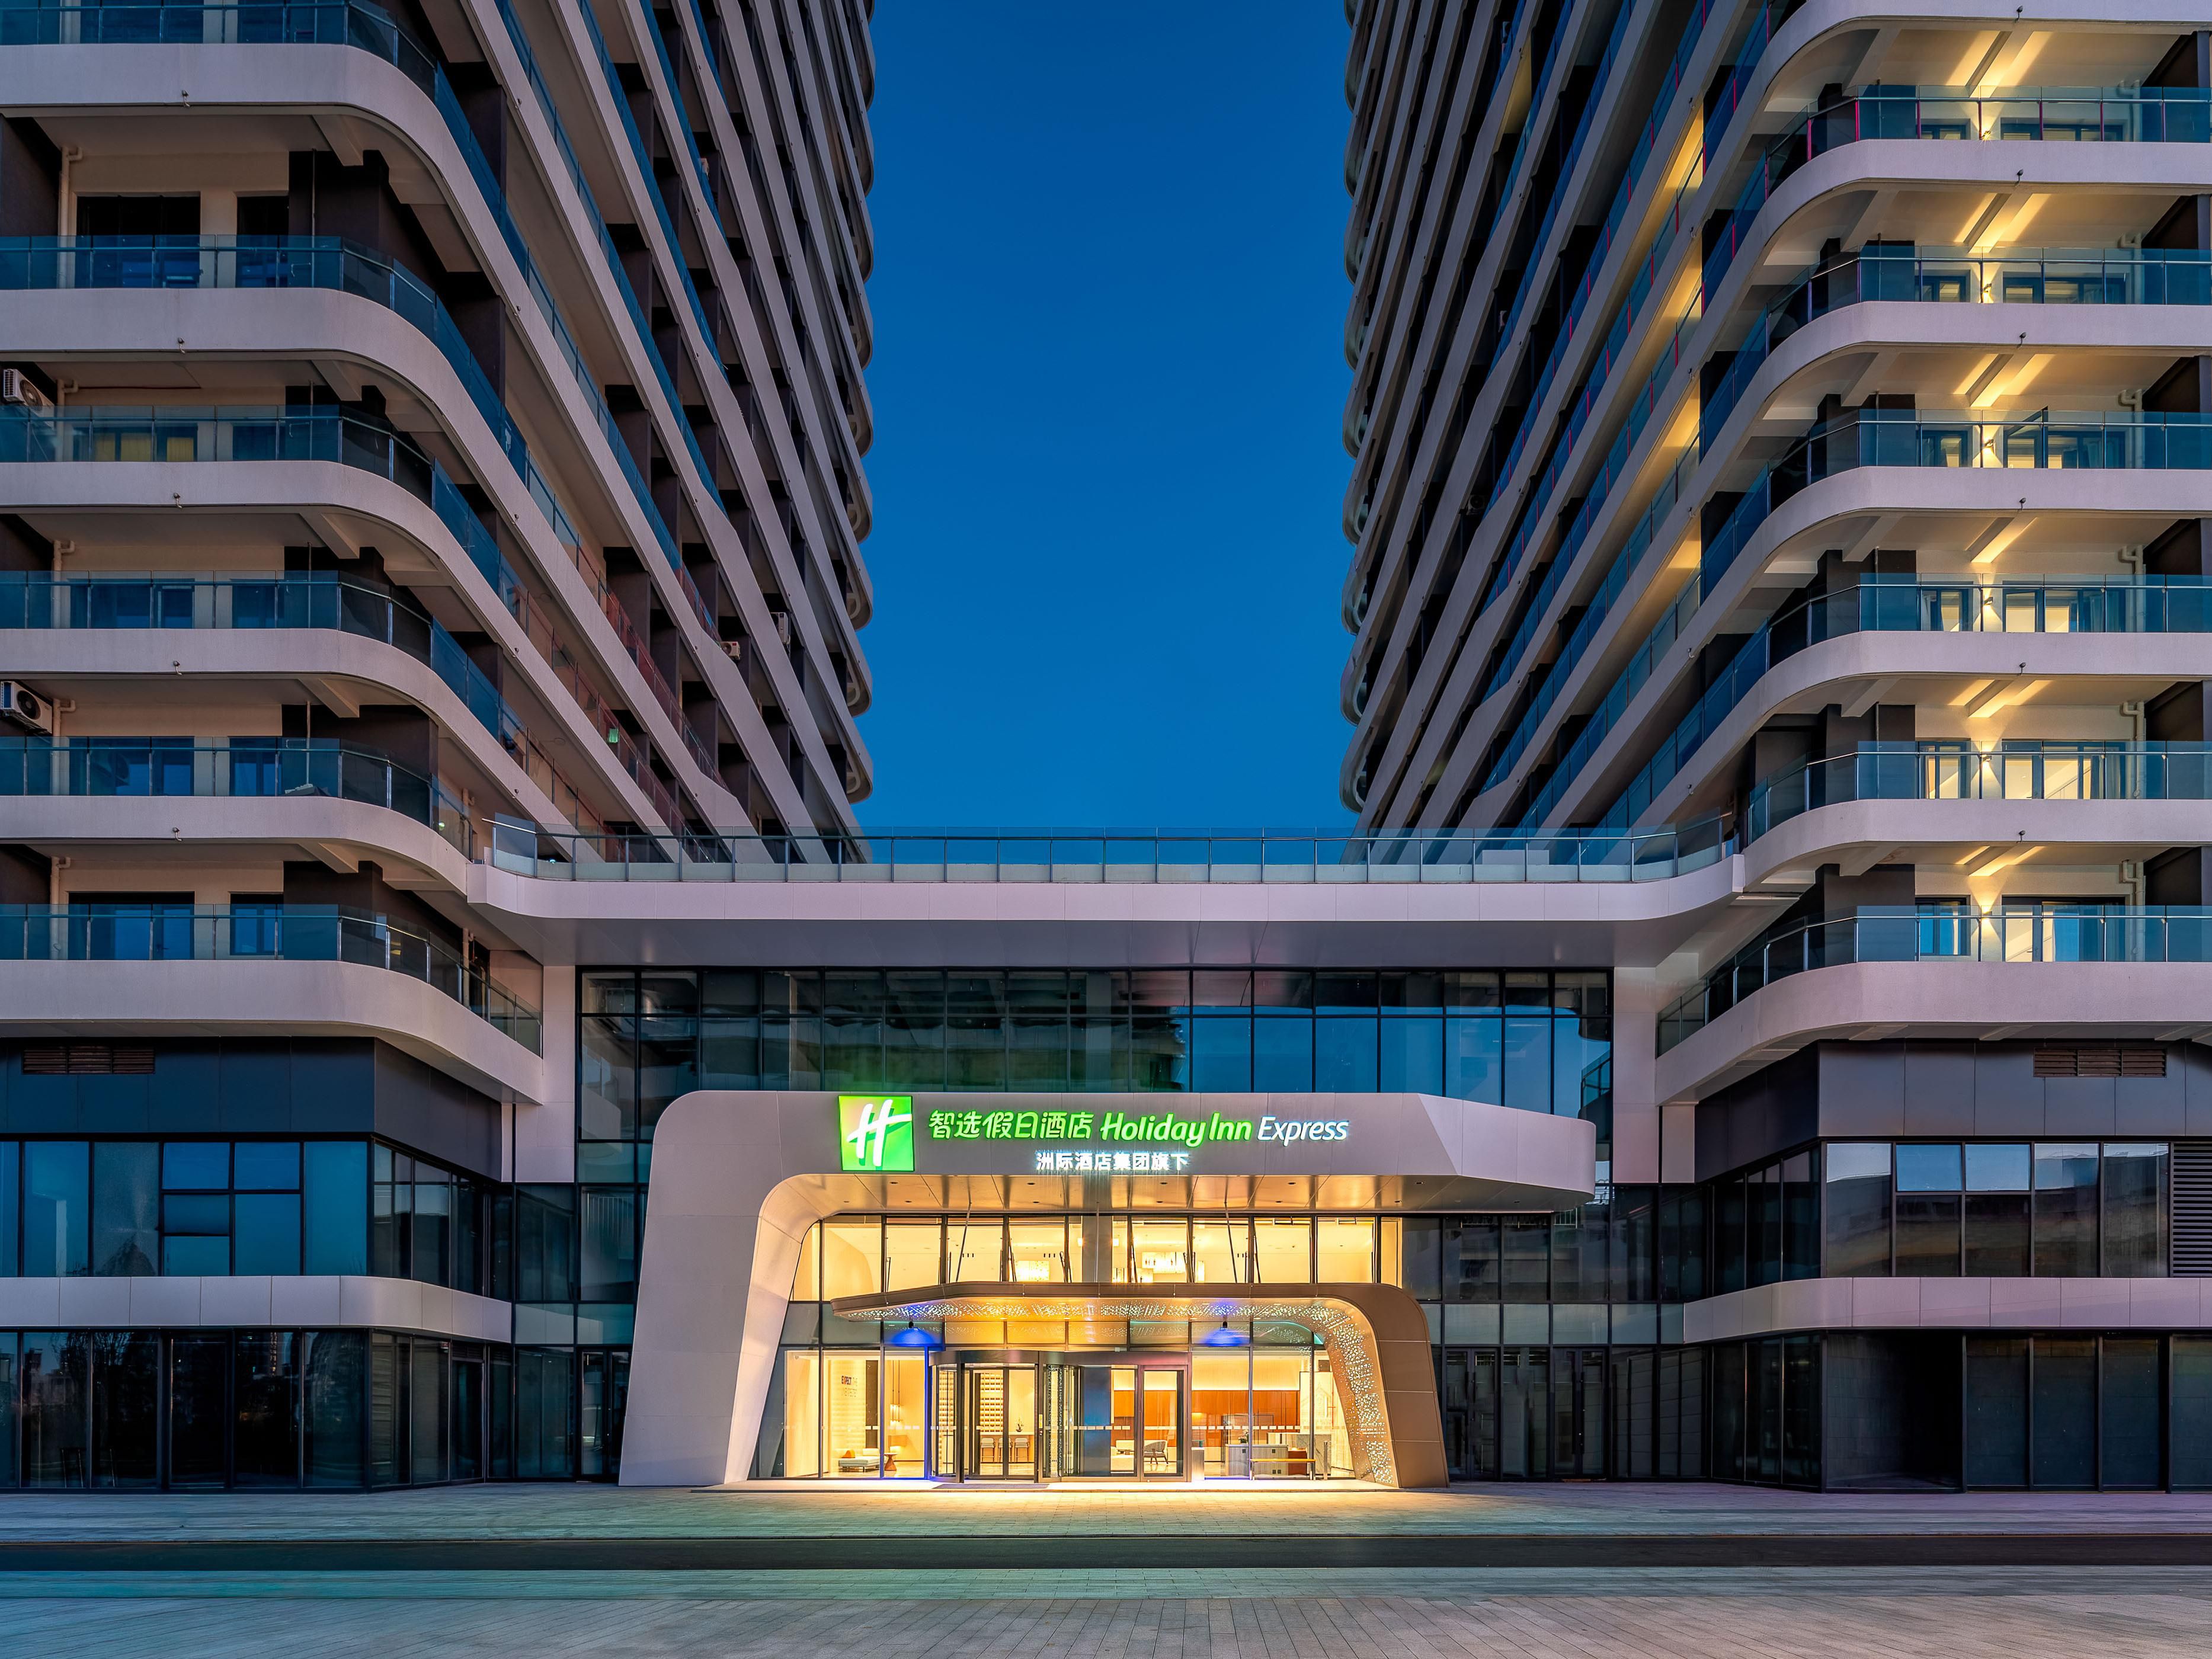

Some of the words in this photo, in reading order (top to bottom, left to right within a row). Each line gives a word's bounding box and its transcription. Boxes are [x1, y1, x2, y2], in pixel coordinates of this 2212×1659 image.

[929, 1109, 1095, 1139] 智选假日酒店
[1100, 1112, 1206, 1147] Holiday
[1208, 1112, 1253, 1142] Inn
[1257, 1116, 1349, 1147] Express
[1036, 1151, 1190, 1171] 洲际酒店集团旗下
